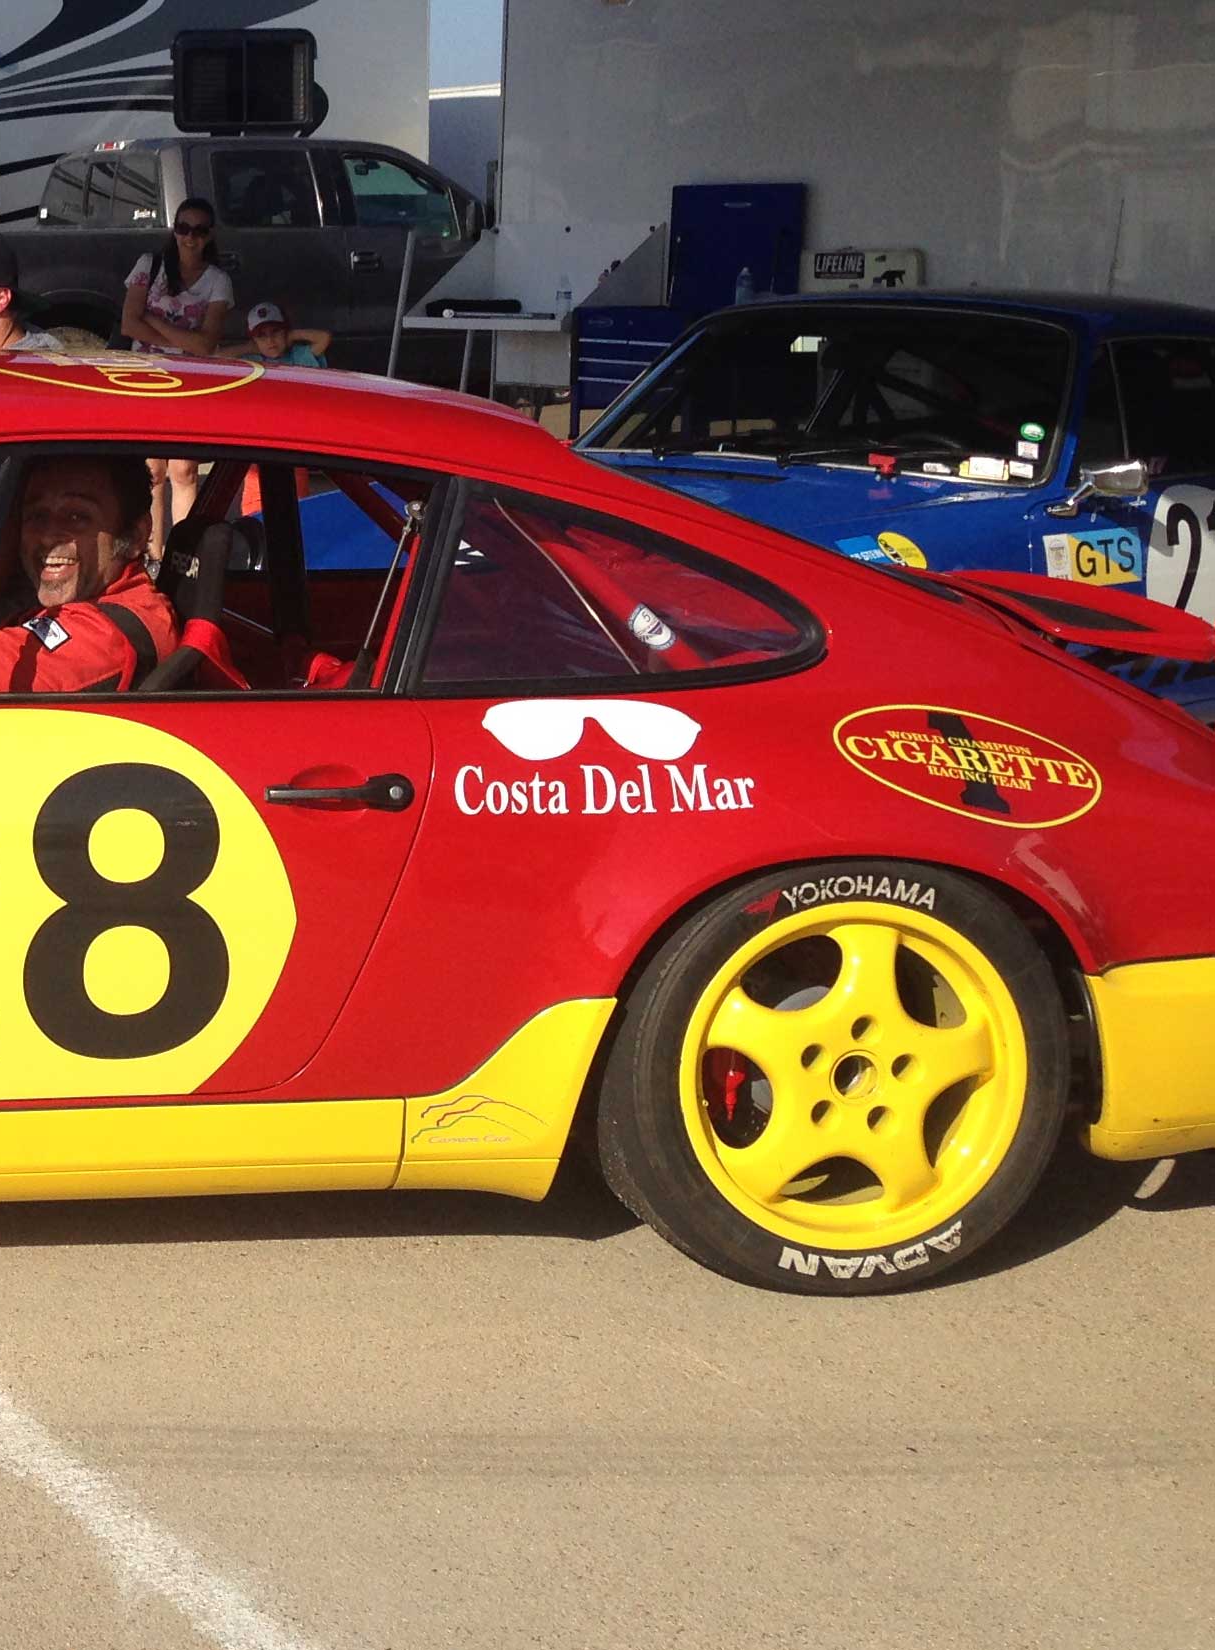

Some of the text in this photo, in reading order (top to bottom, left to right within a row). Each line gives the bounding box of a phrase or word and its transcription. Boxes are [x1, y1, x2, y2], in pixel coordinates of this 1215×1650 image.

[816, 255, 864, 273] LIFELINE
[1075, 536, 1136, 578] GTS
[845, 735, 1095, 789] CIGARETTE
[886, 729, 1032, 756] WORLD CHAMPION
[454, 764, 755, 815] Costa Del Mar
[928, 764, 1033, 791] RACING TEAM
[782, 875, 936, 911] YOKOHAMA
[778, 1220, 962, 1279] ADVAN
